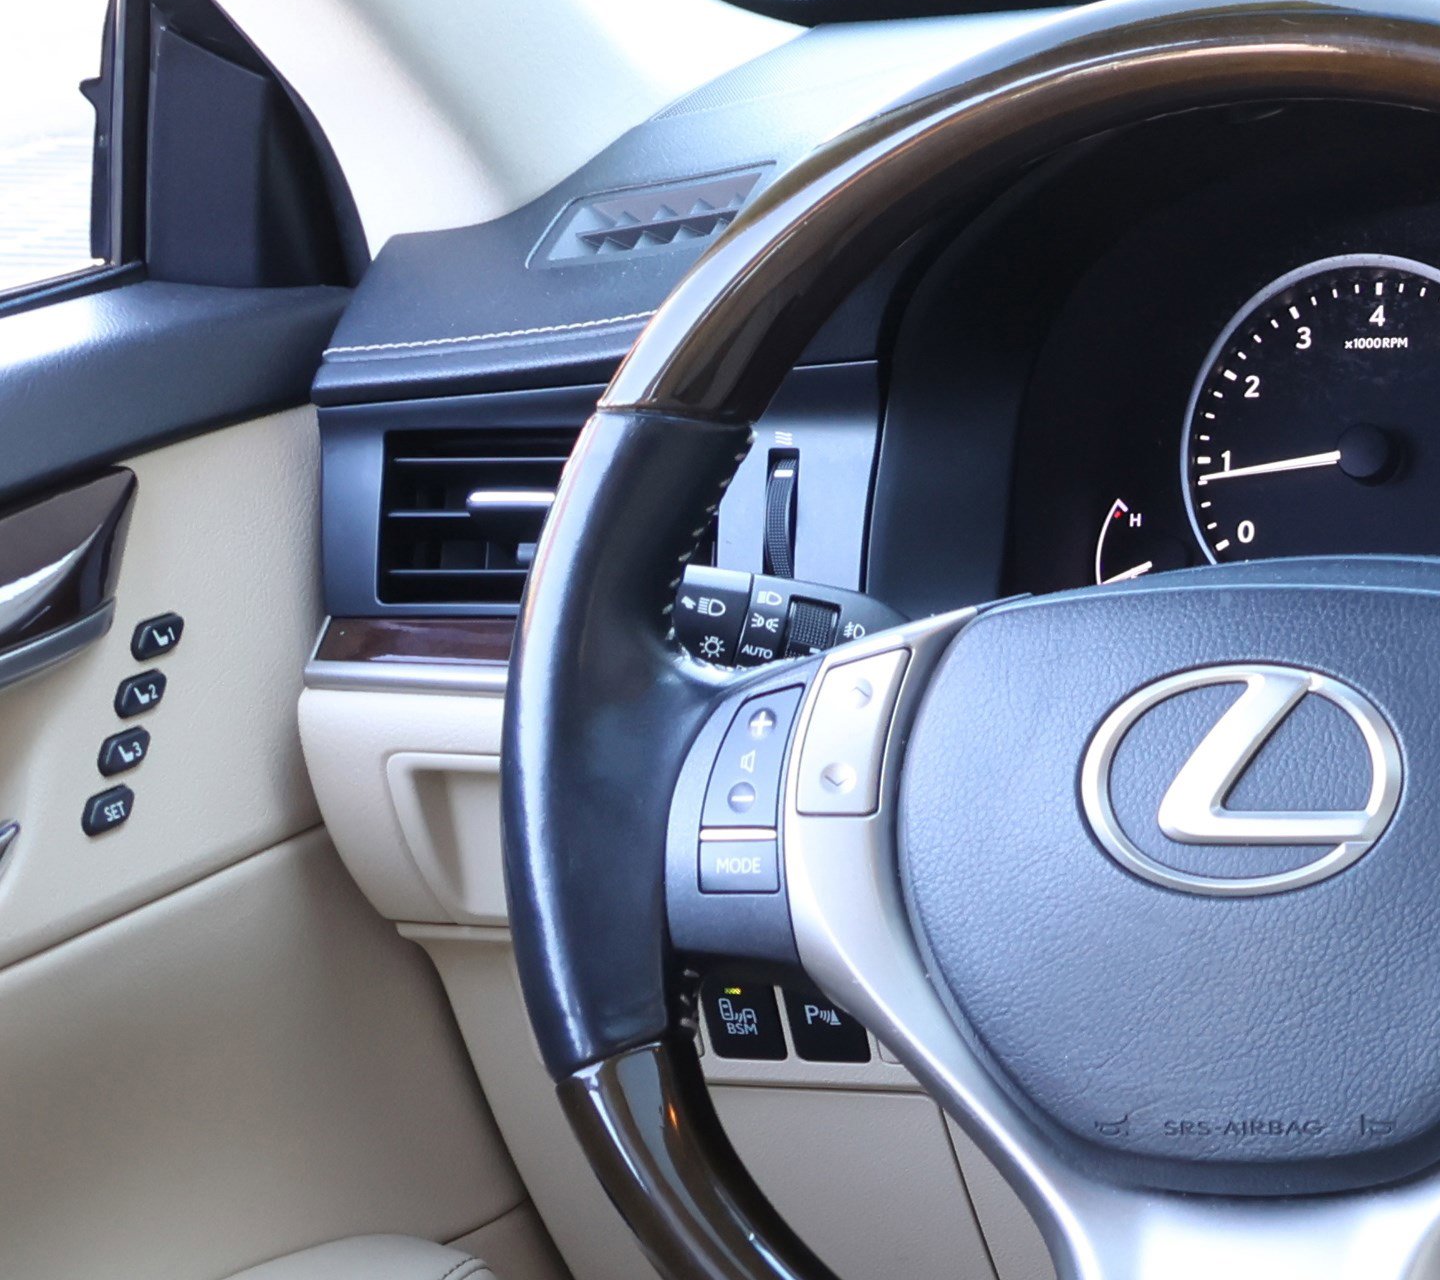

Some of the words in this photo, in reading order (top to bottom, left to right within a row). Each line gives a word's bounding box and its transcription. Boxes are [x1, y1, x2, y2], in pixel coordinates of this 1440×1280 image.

[1368, 304, 1386, 327] 4
[1295, 326, 1312, 350] 3
[1243, 375, 1261, 399] 2
[1220, 450, 1231, 472] 1
[1129, 513, 1142, 527] H
[1236, 520, 1256, 544] 0
[167, 626, 177, 642] 1
[741, 643, 773, 660] AUTO
[148, 683, 159, 700] 2
[132, 741, 143, 757] 3
[104, 800, 126, 822] SET
[715, 856, 762, 874] MODE
[727, 1022, 758, 1035] BSM
